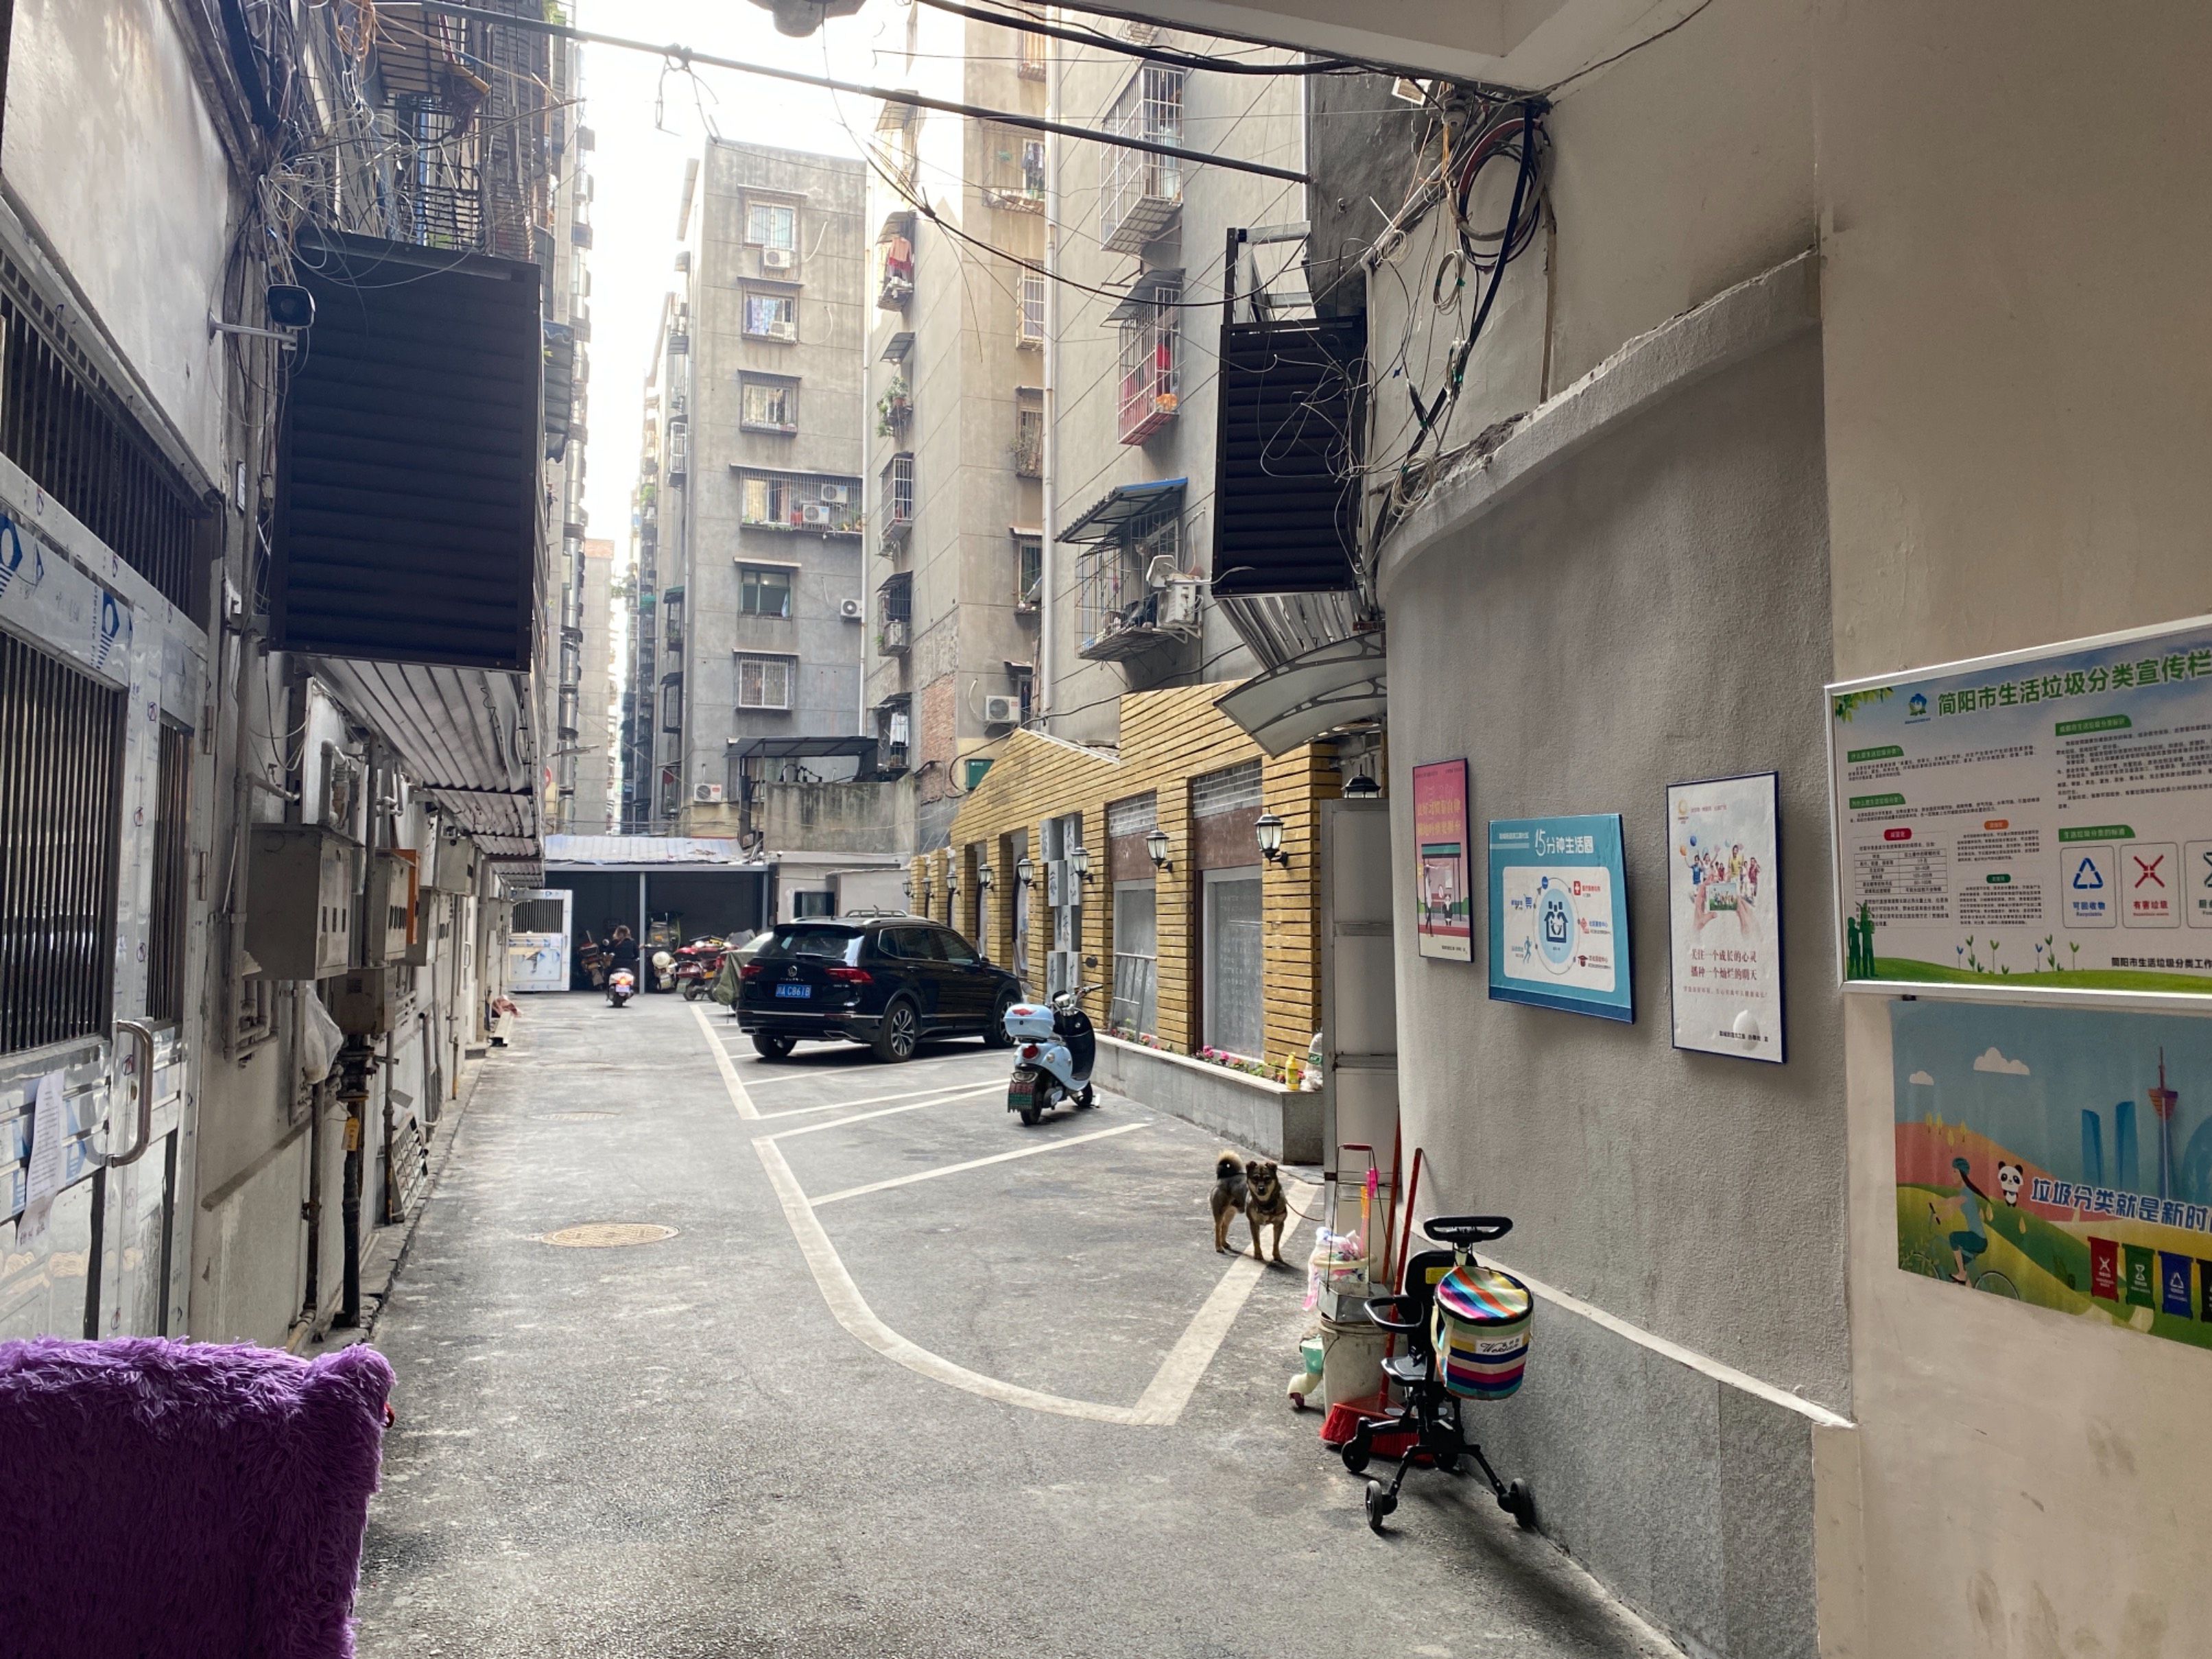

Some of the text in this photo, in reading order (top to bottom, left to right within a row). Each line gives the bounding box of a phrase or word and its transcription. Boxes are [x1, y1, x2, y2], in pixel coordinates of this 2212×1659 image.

[1937, 649, 2212, 717] 简阳市生活垃圾分类宣传栏
[2073, 901, 2106, 911] 可回收物
[2133, 900, 2169, 910] 有害垃圾
[1691, 948, 1757, 963] 关注一个成长的心灵
[2031, 1178, 2212, 1234] 垃圾分类就是新时
